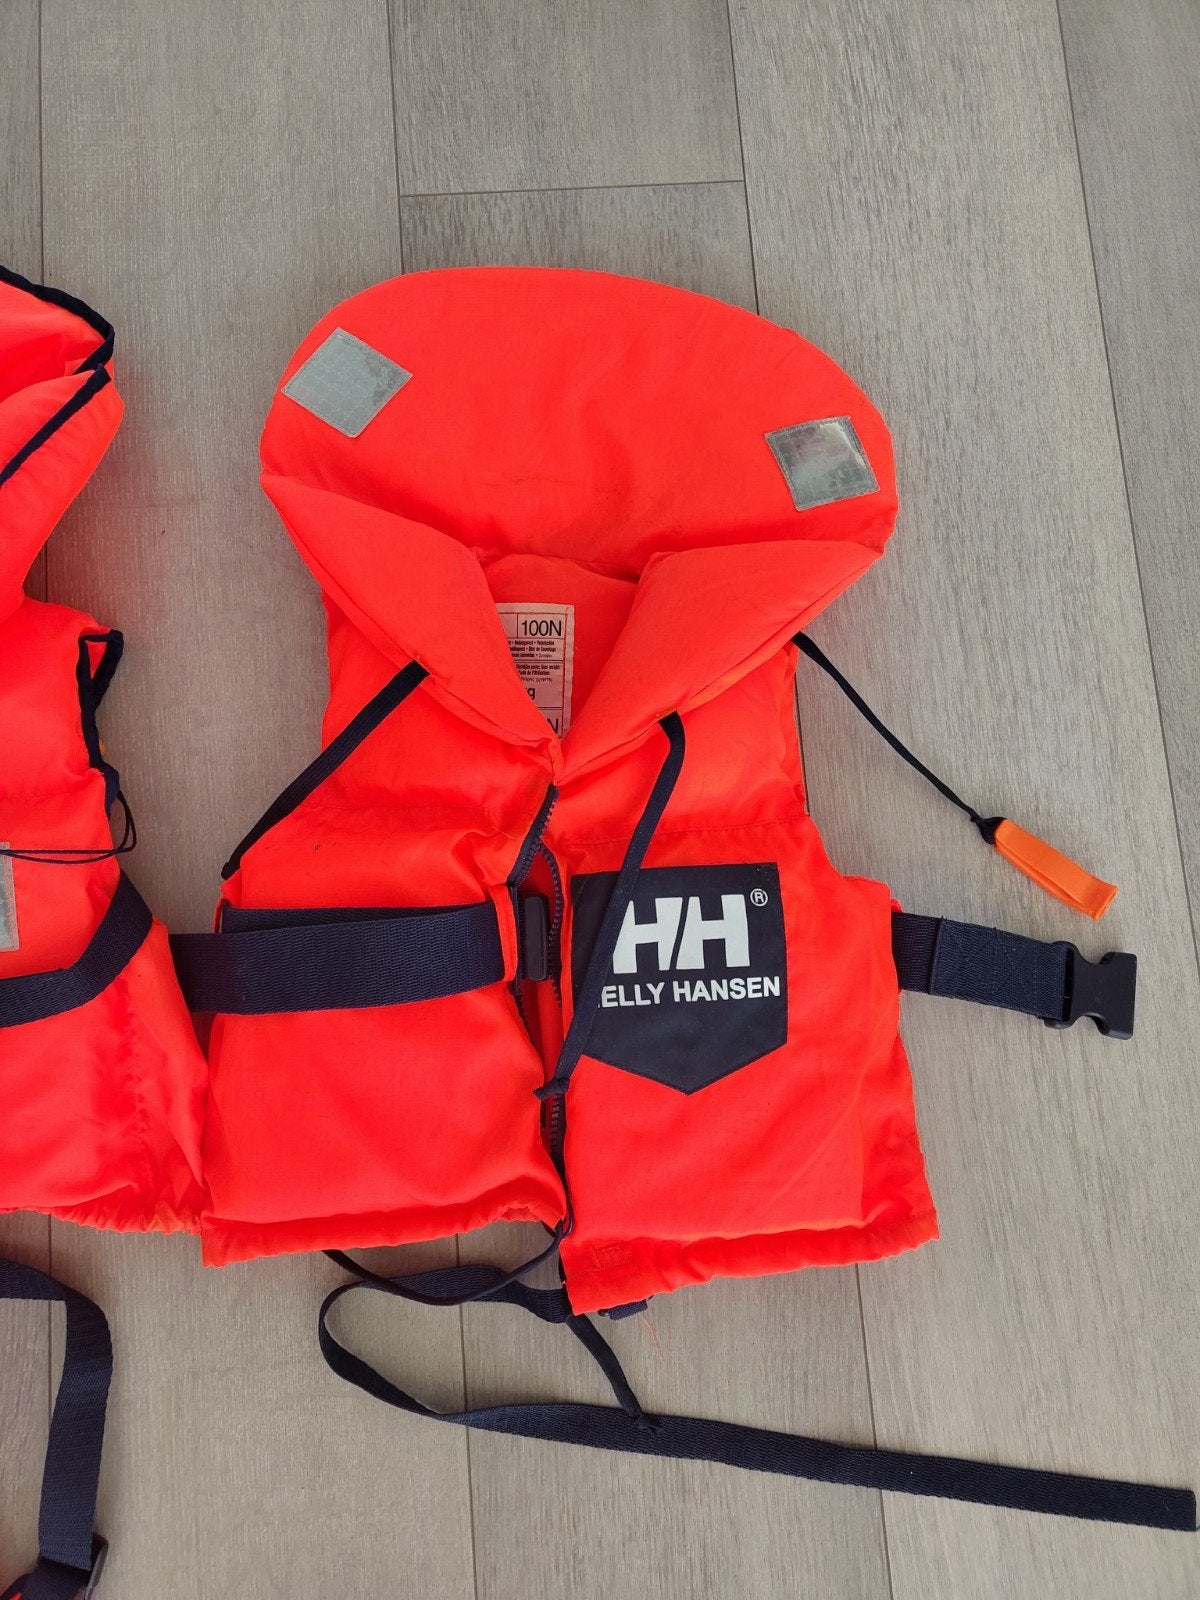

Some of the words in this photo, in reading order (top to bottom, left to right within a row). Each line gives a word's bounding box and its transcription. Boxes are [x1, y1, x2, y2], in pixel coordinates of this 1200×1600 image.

[521, 619, 562, 637] 100N
[612, 893, 751, 975] HH
[598, 981, 665, 1009] ELLY
[672, 975, 781, 1003] HANSEN
